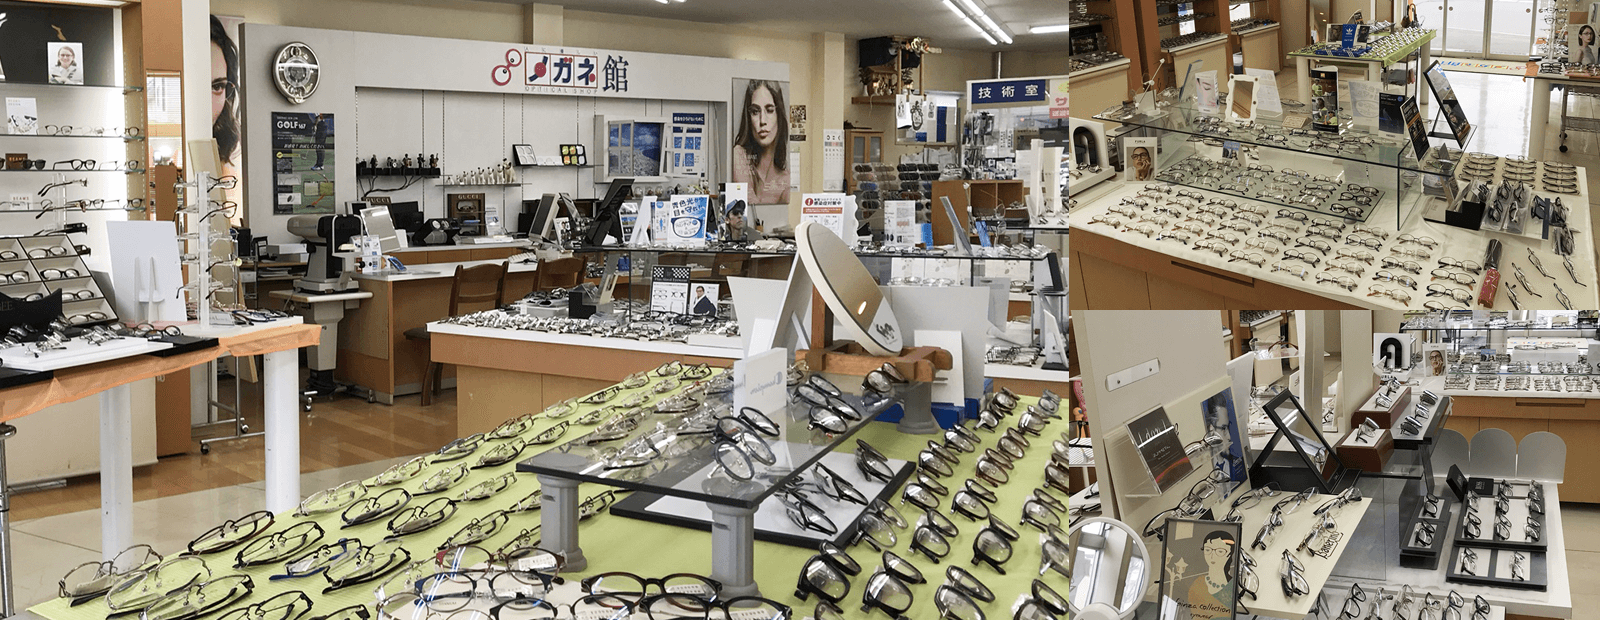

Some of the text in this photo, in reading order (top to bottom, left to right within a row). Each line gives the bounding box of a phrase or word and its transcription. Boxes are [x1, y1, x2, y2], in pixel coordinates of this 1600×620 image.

[525, 85, 568, 93] OPTICAL
[978, 84, 1039, 99] 技術室
[277, 121, 298, 129] GOLF
[1199, 603, 1231, 614] collection
